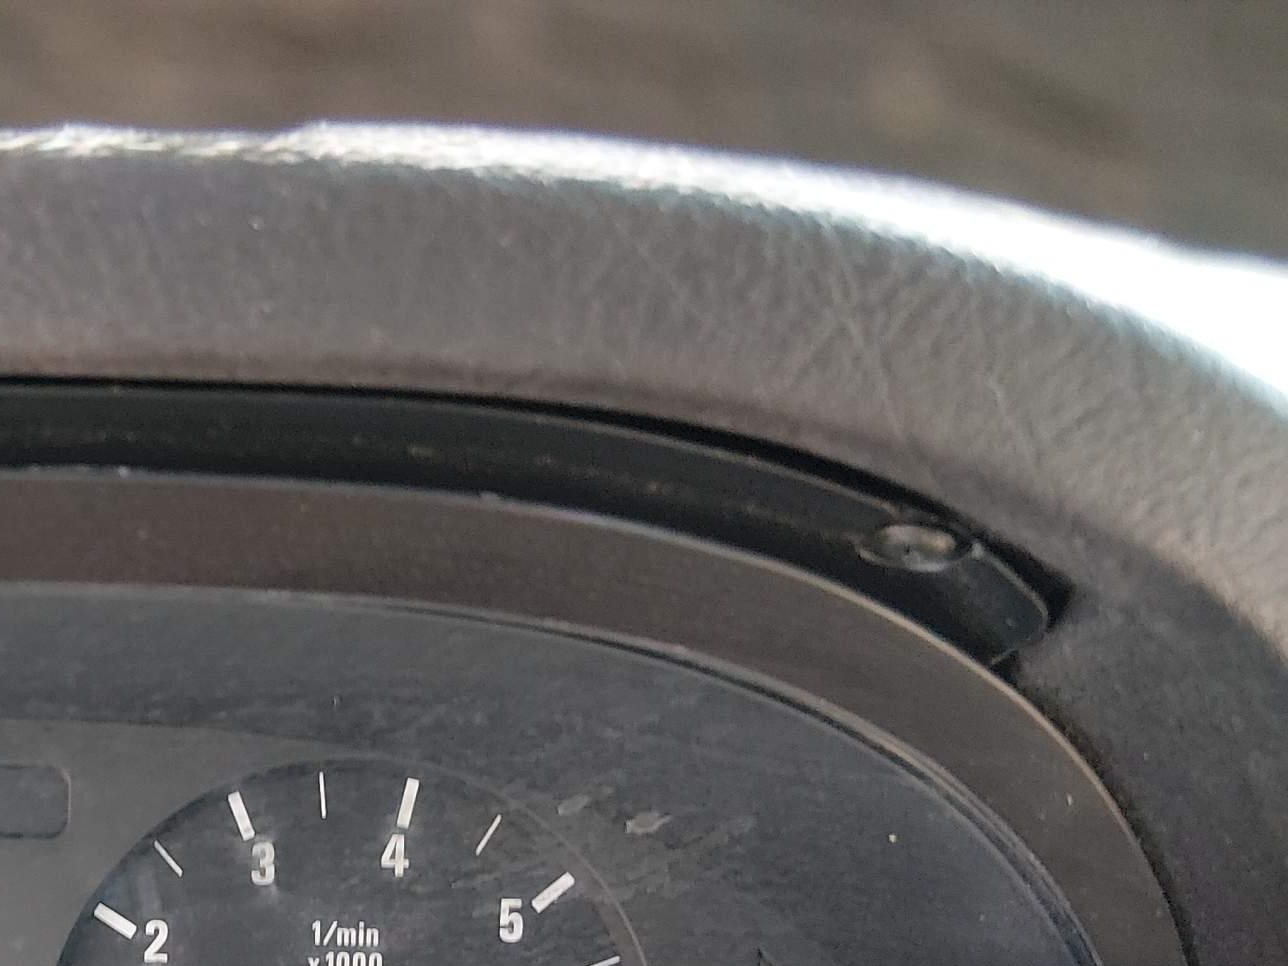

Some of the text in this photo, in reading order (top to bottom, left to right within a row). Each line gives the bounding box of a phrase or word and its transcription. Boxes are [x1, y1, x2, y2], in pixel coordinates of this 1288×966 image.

[251, 842, 276, 886] 3
[380, 834, 410, 878] 4
[143, 920, 169, 964] 2
[312, 921, 379, 947] 1/min
[499, 898, 524, 943] 5
